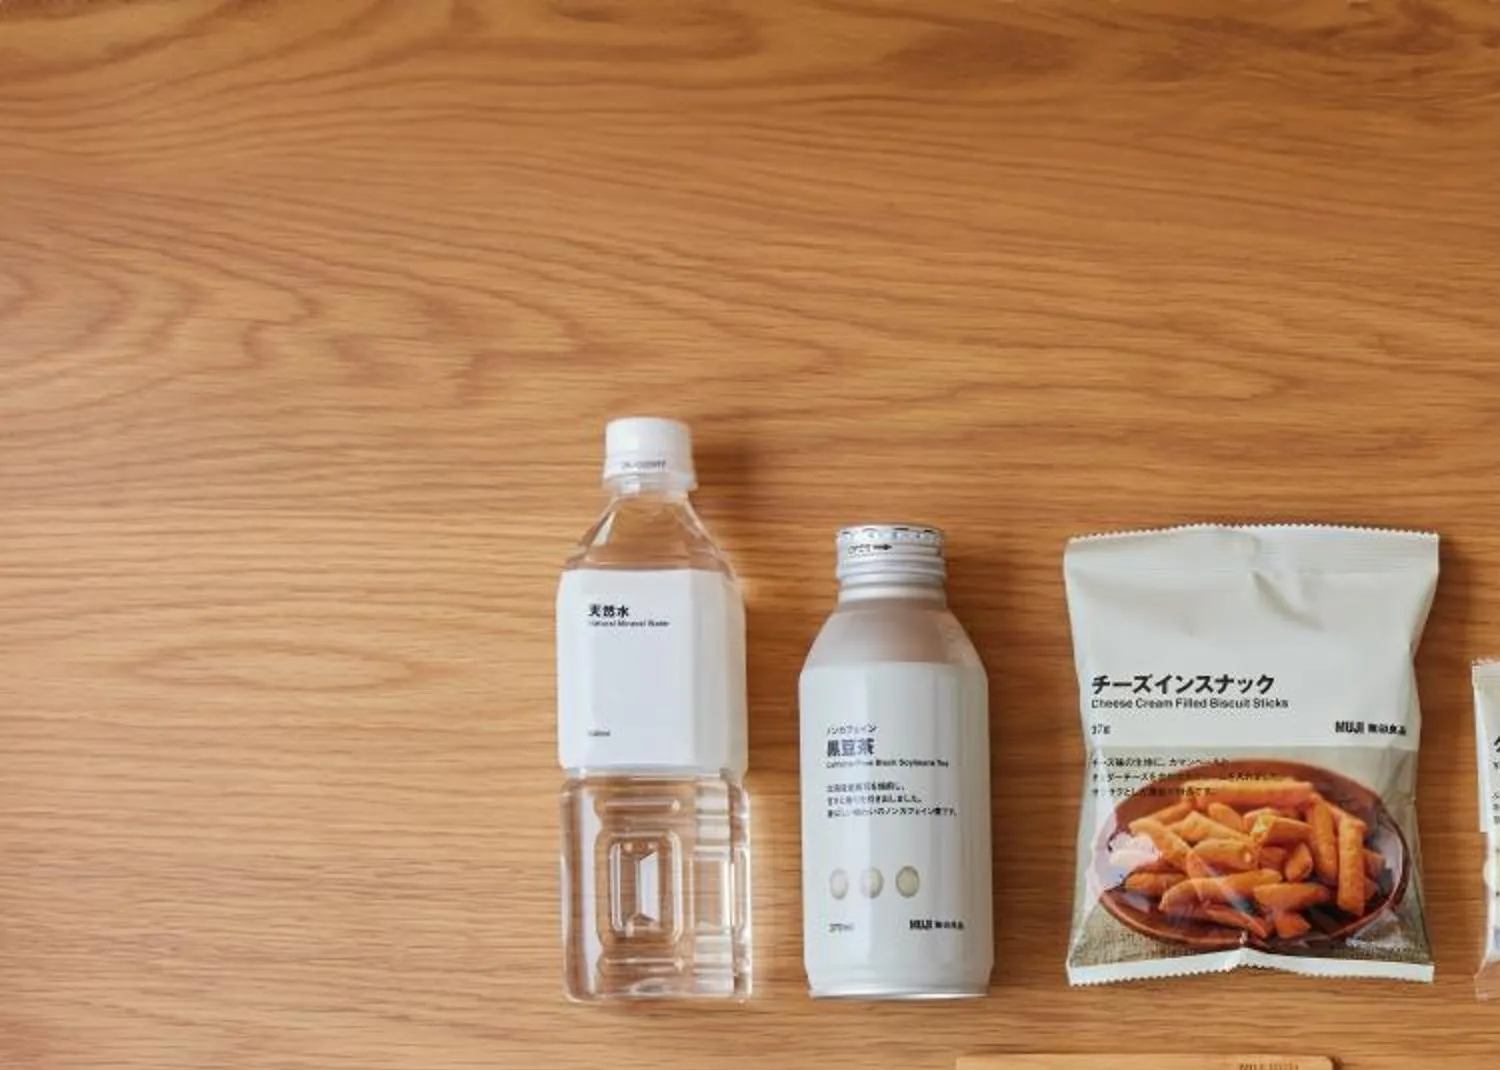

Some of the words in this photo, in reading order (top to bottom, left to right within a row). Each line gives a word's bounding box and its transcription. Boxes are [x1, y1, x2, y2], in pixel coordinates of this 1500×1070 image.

[588, 604, 629, 617] 天然水
[1091, 674, 1275, 695] チーズインスナック
[1091, 698, 1133, 709] Cheese
[1135, 698, 1173, 709] Cream
[1175, 698, 1207, 709] Filled
[1209, 698, 1250, 709] Biscuit
[1253, 698, 1289, 709] Sticks
[1335, 721, 1364, 734] MUJI
